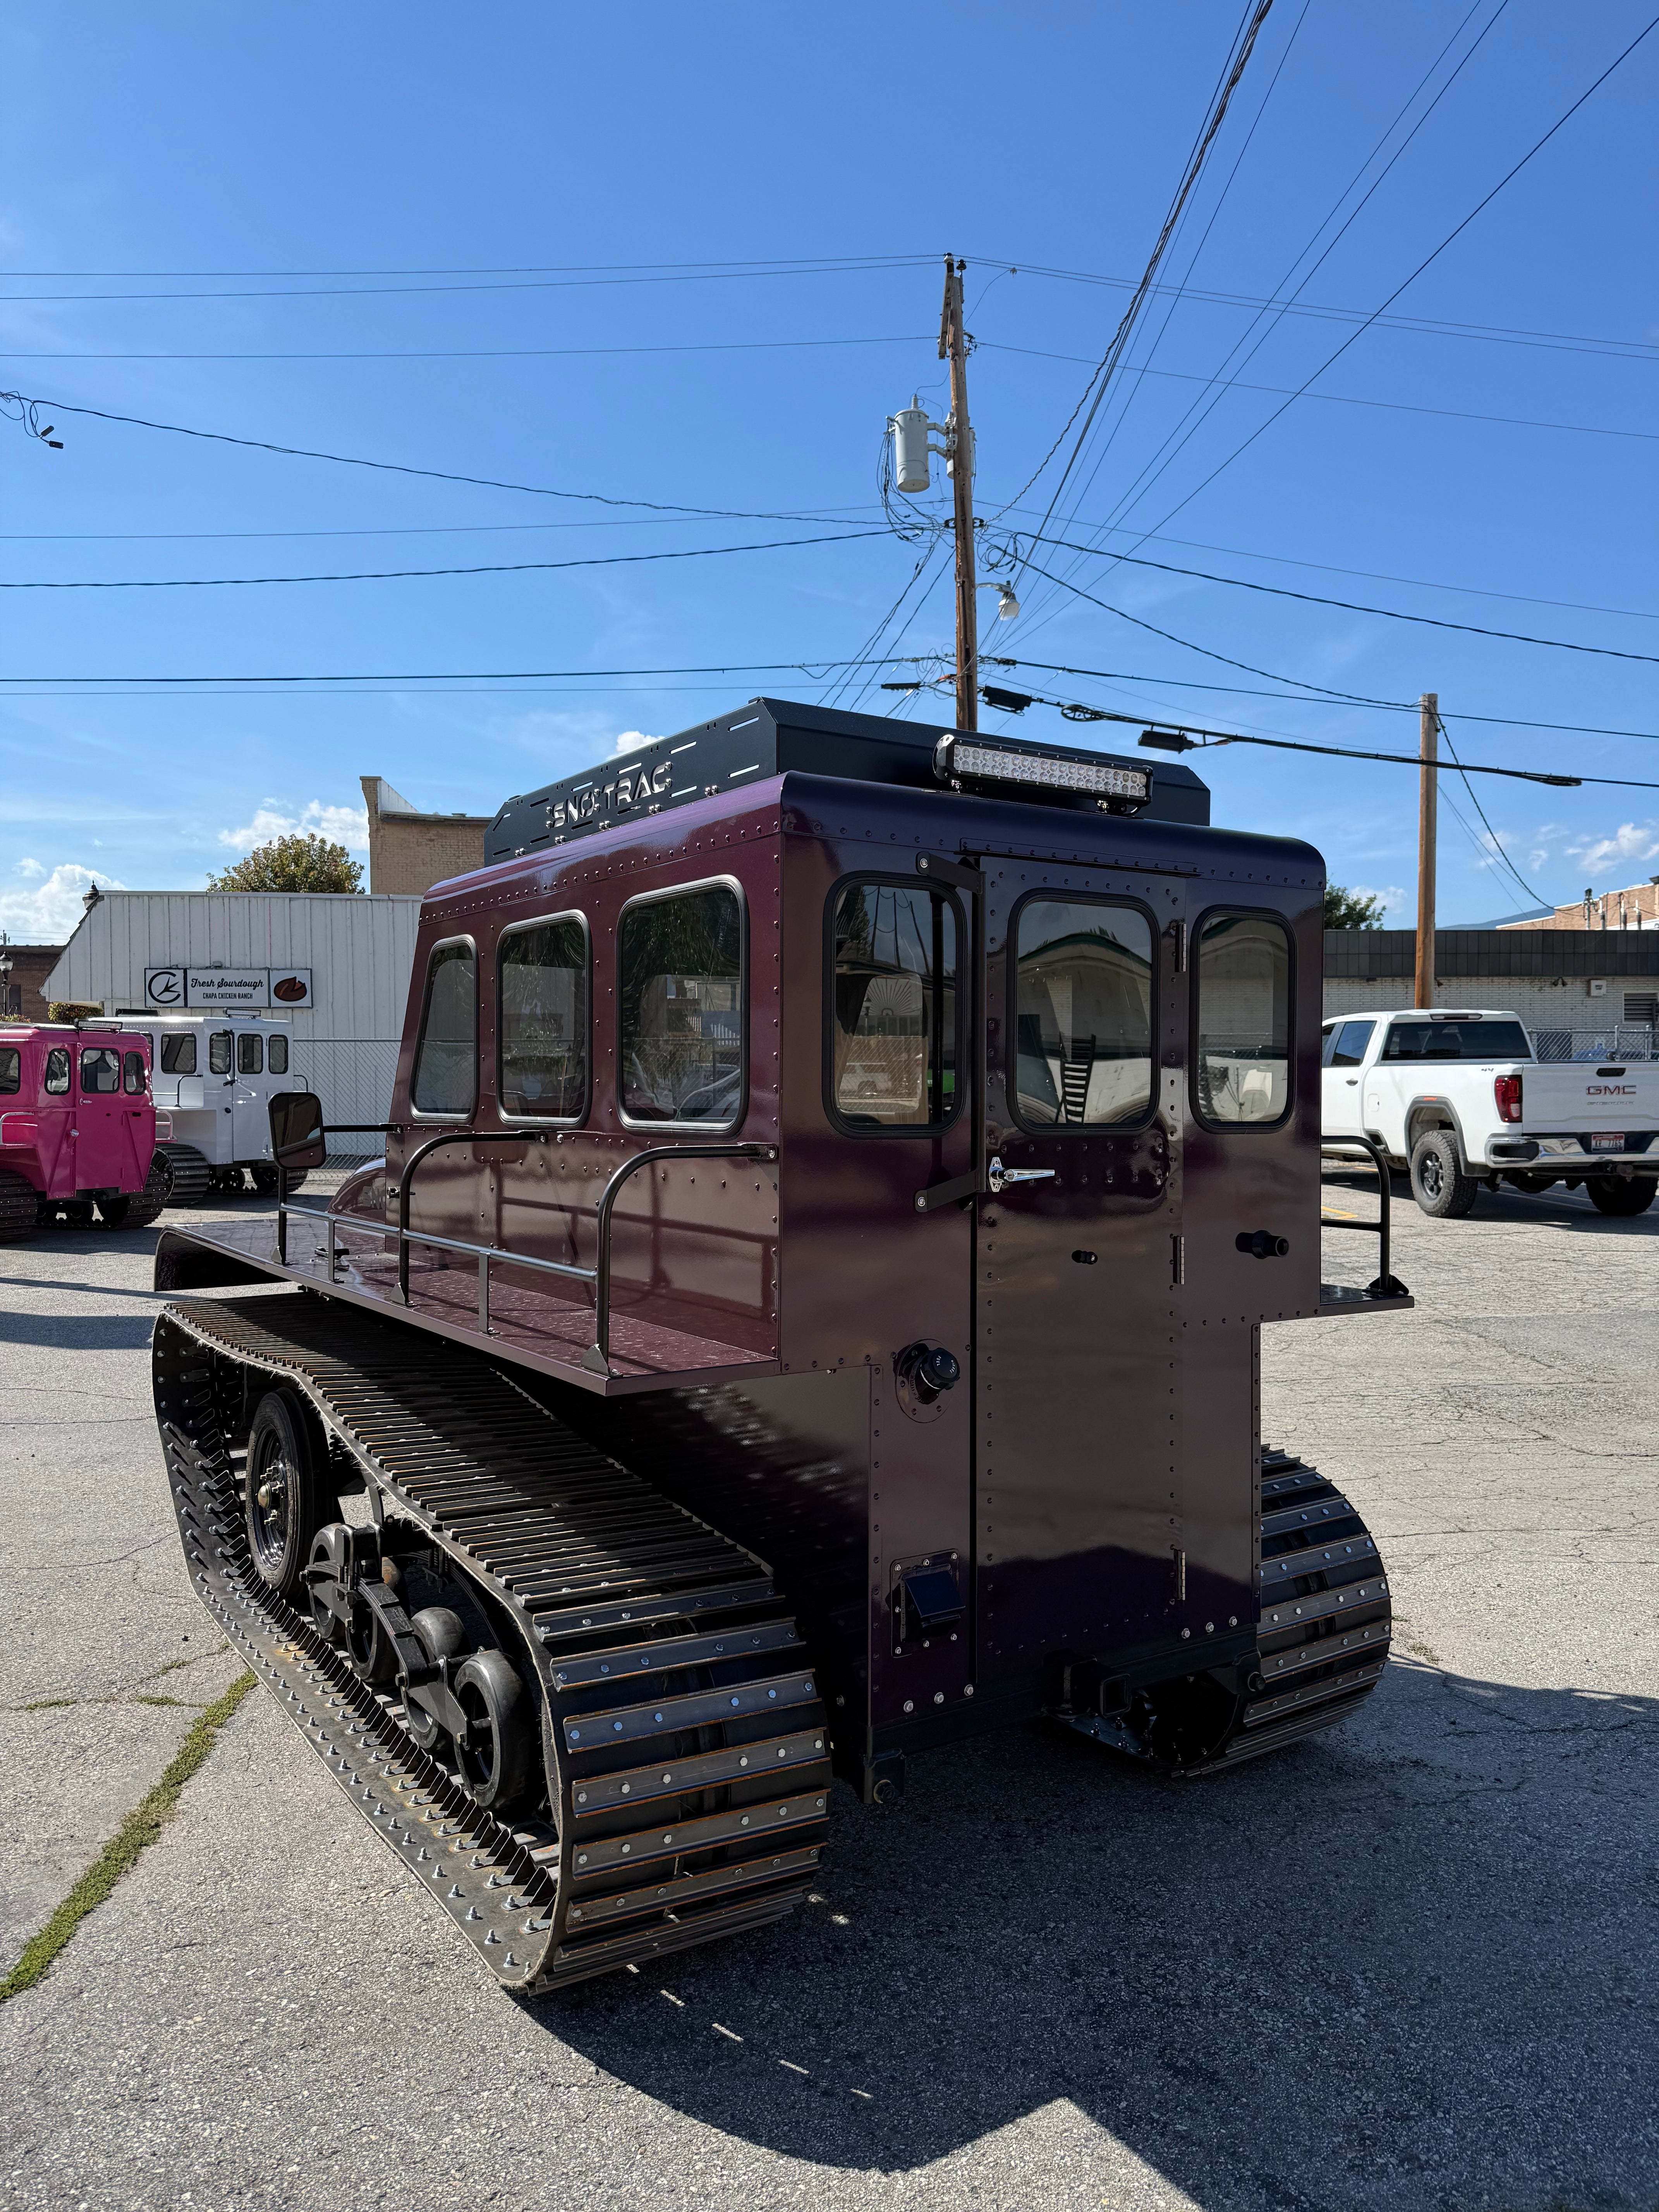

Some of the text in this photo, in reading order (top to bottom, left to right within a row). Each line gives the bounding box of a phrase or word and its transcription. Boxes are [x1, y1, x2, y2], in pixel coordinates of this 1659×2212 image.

[191, 978, 264, 990] Fresh Sourdough
[1586, 1085, 1637, 1095] GMC
